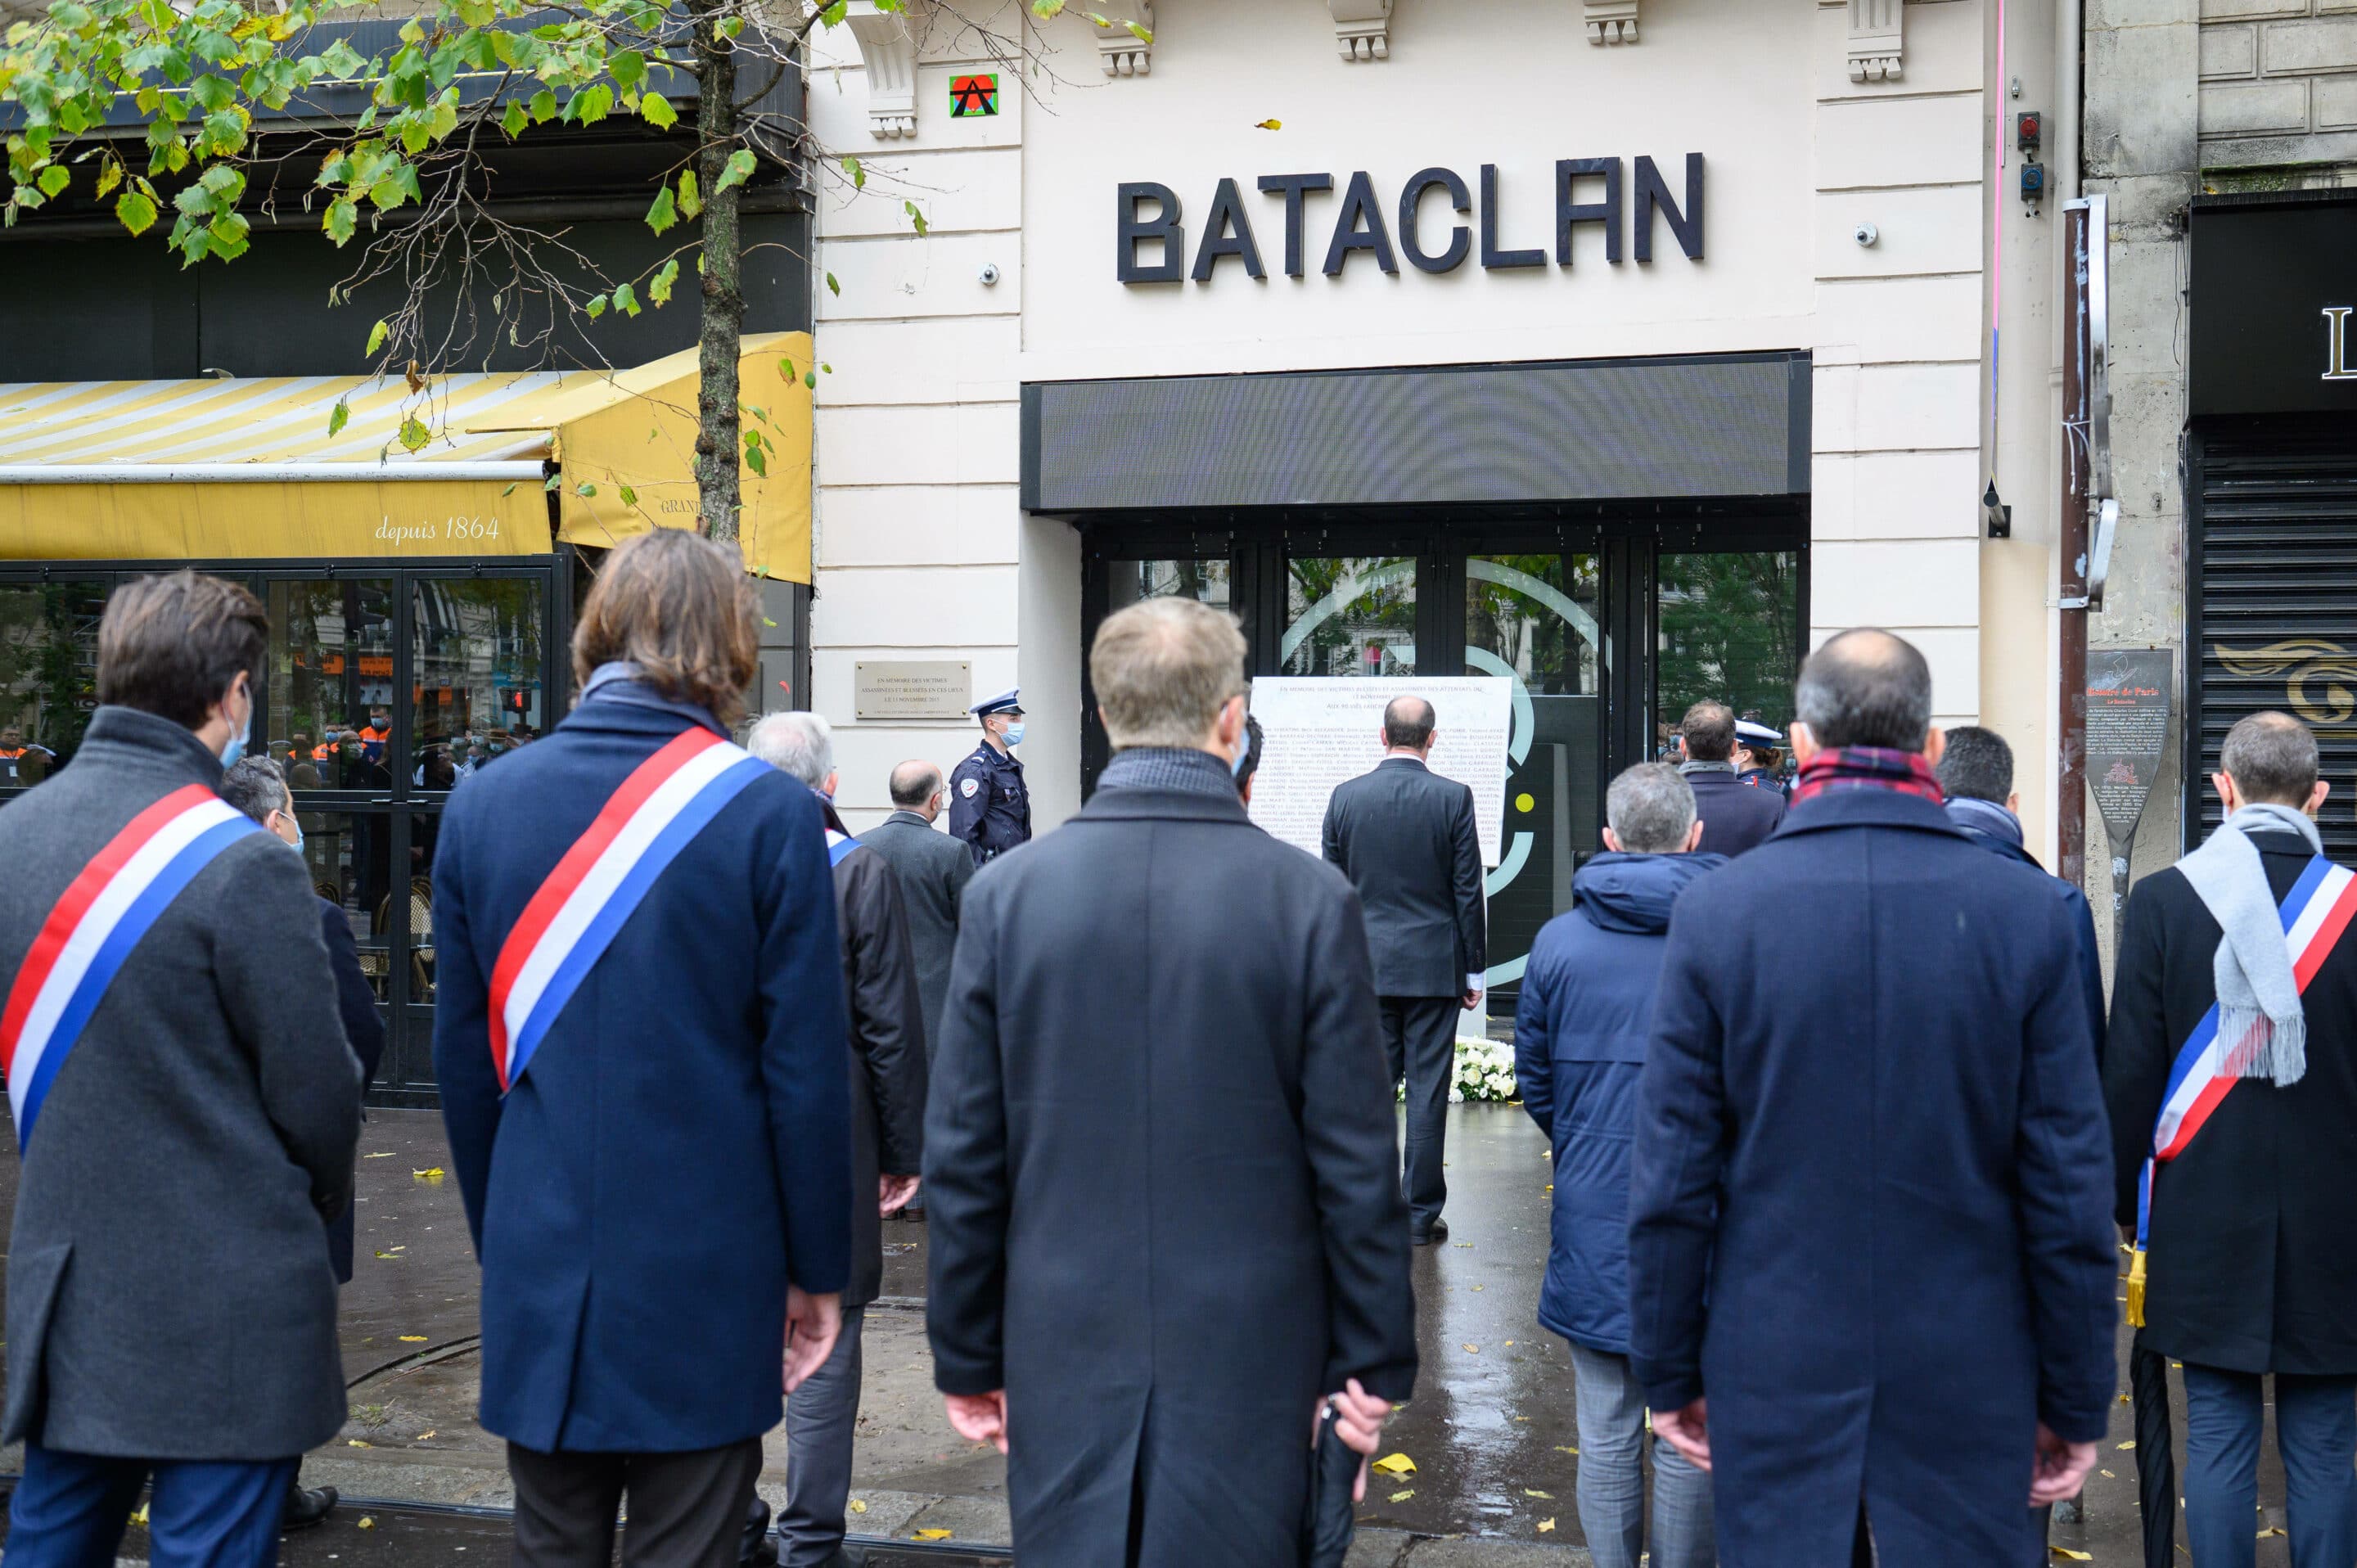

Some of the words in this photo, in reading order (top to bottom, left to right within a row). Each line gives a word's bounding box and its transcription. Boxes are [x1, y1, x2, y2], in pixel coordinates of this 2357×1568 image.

[1117, 152, 1706, 285] BATACLAN
[375, 515, 437, 546] depuis
[445, 516, 499, 539] 1864
